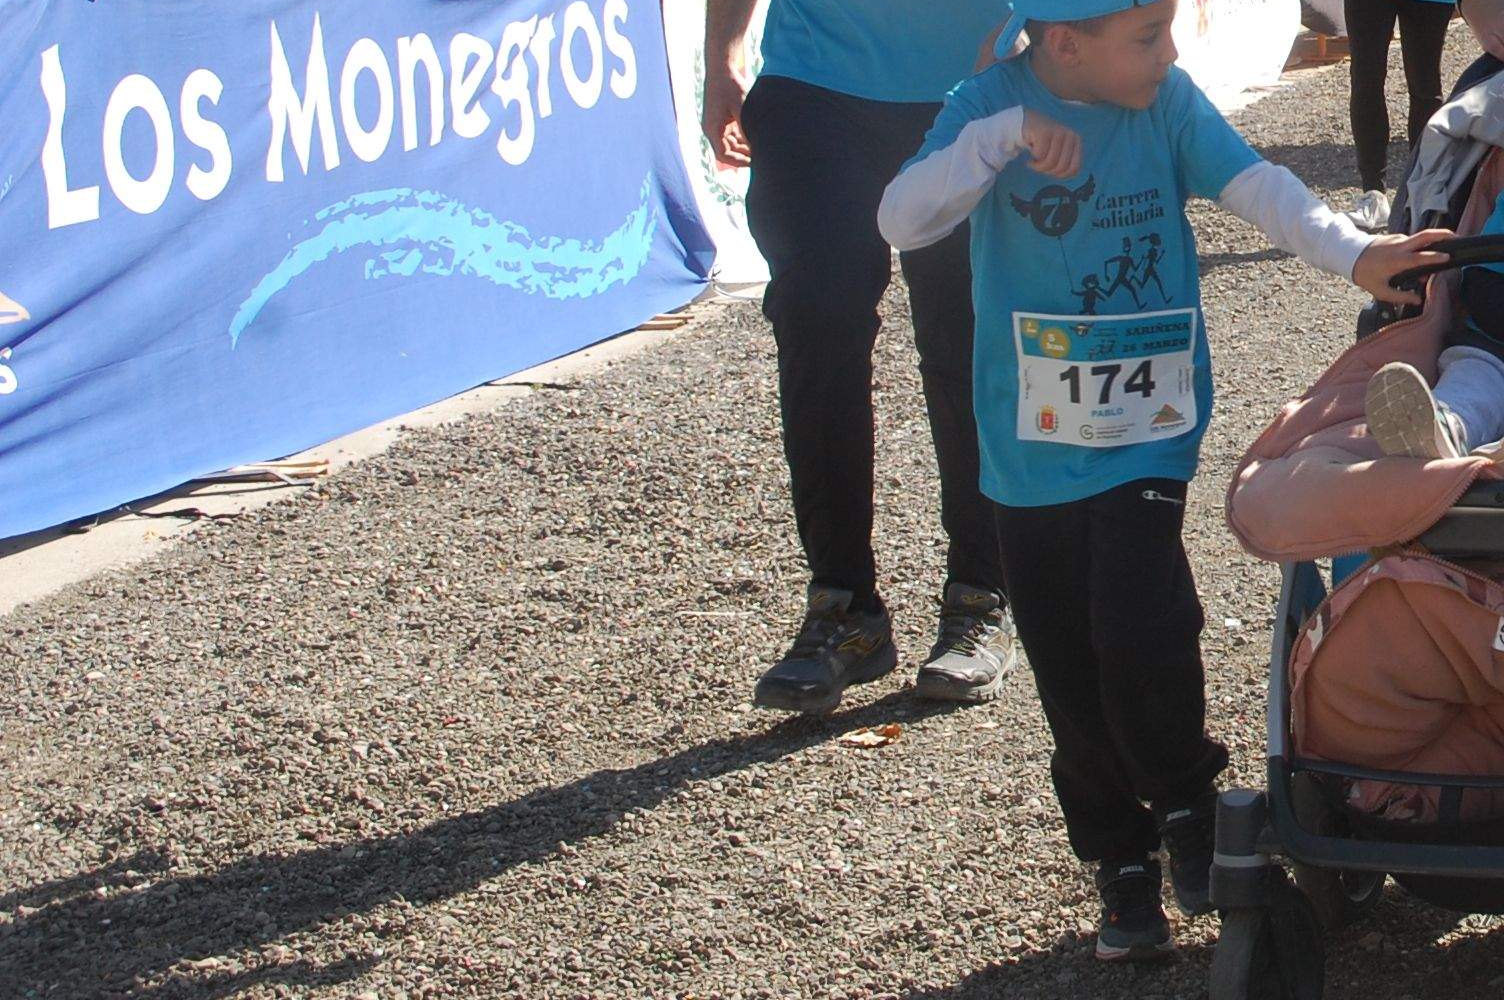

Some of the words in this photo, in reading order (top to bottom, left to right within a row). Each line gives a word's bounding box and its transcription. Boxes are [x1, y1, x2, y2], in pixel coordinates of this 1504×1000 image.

[41, 43, 232, 229] Los
[1096, 187, 1160, 211] Carrera
[1092, 203, 1164, 229] solidaria
[1143, 338, 1188, 351] MARZO
[1059, 359, 1156, 405] 174
[1091, 407, 1124, 418] PABLO
